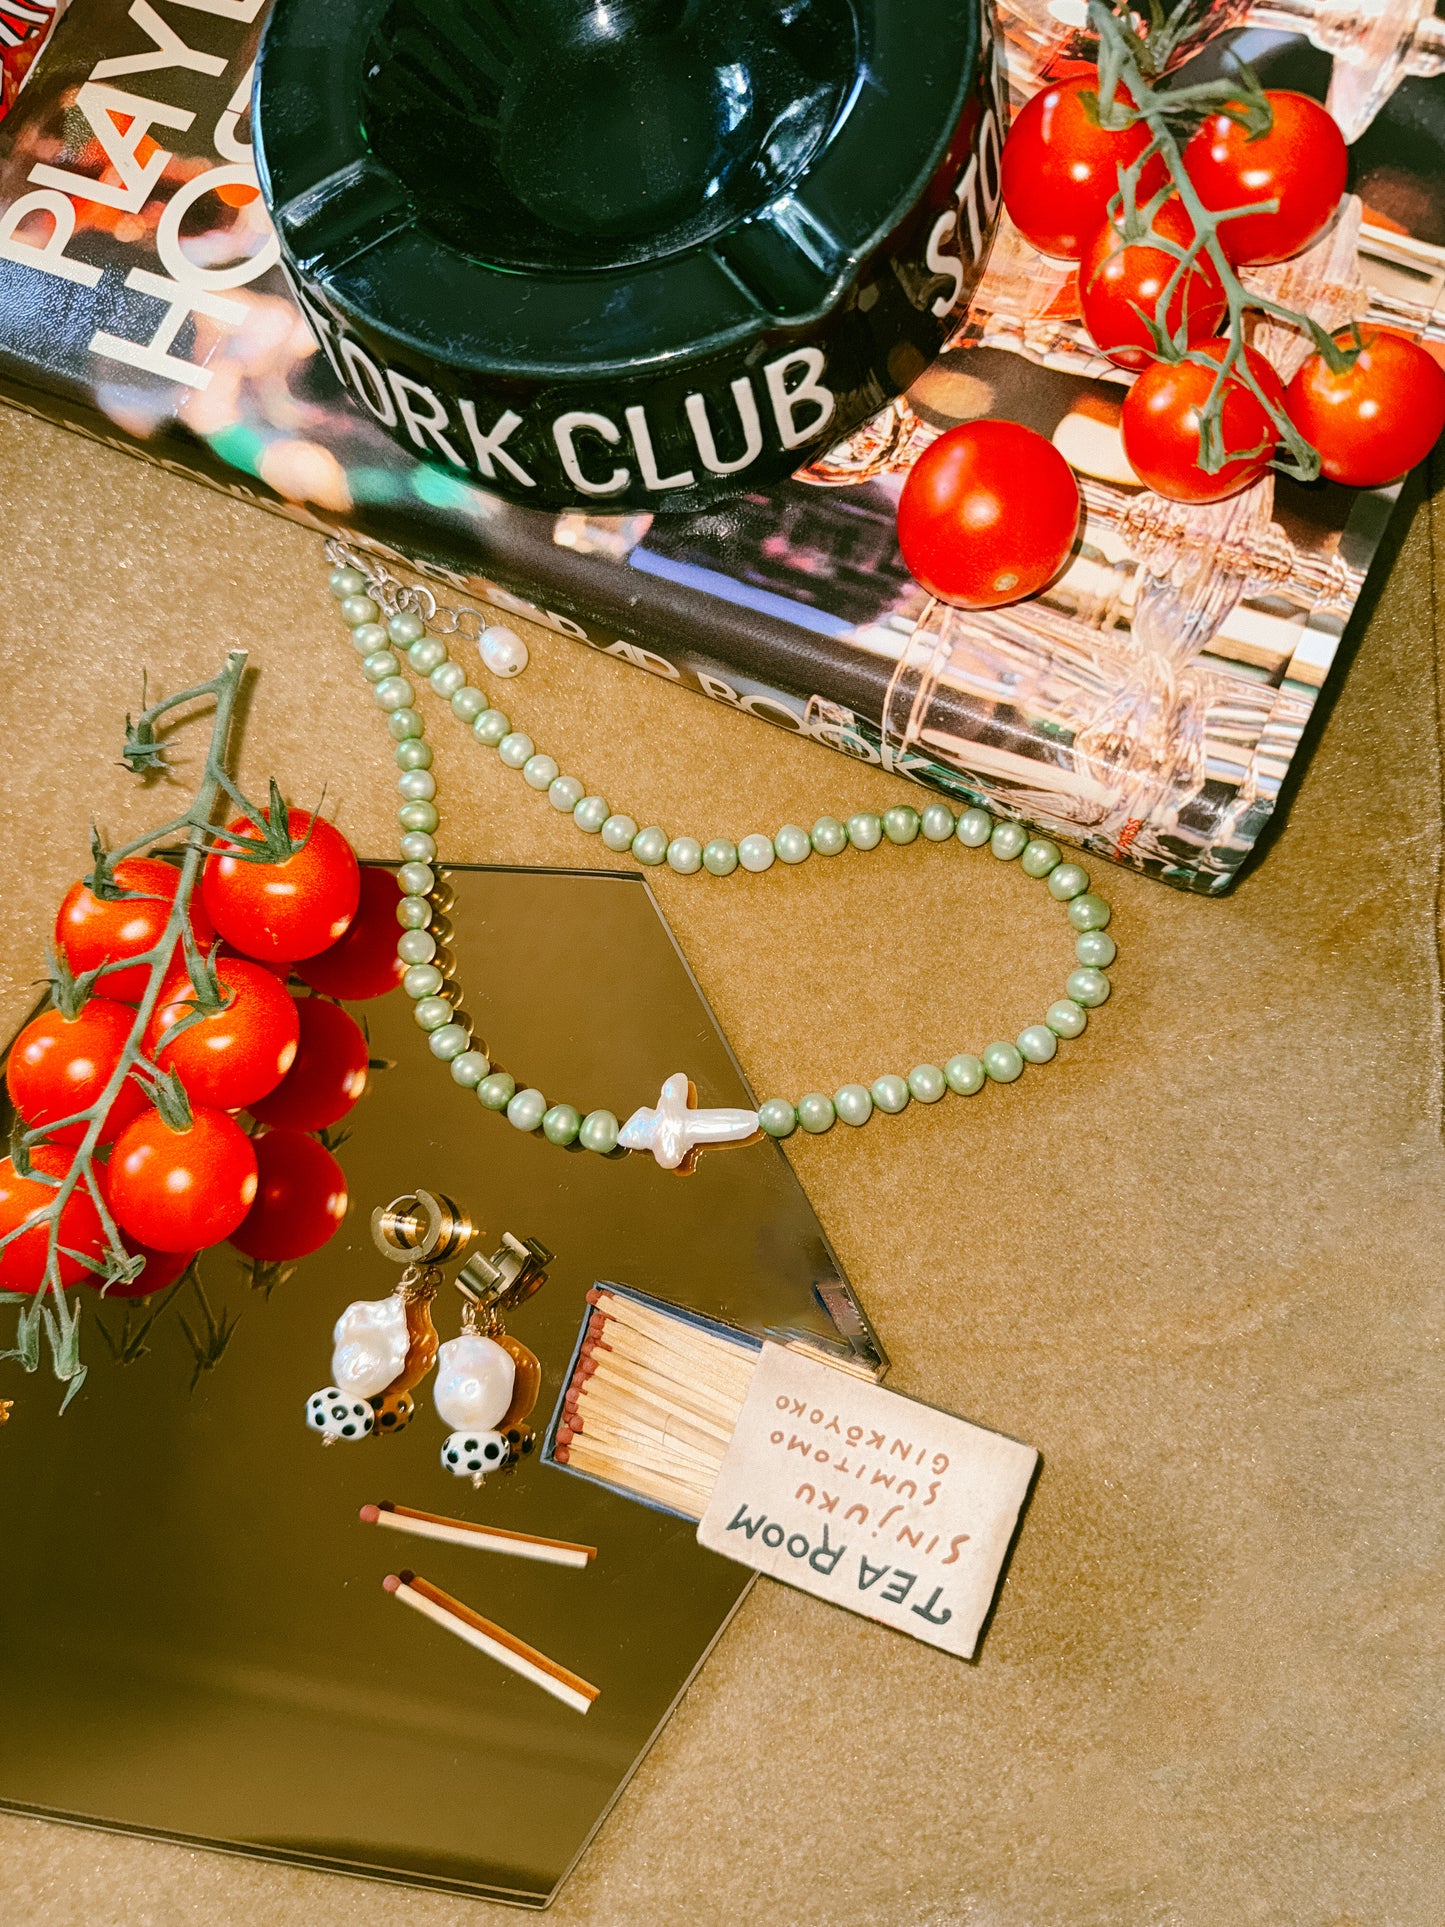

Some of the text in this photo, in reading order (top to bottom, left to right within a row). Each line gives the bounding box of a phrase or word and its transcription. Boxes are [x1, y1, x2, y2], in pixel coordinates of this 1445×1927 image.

[552, 347, 834, 494] CLUB
[697, 671, 937, 790] BOOK
[770, 1429, 942, 1506] SUMITOMO
[726, 1503, 952, 1625] TEA ROOM
